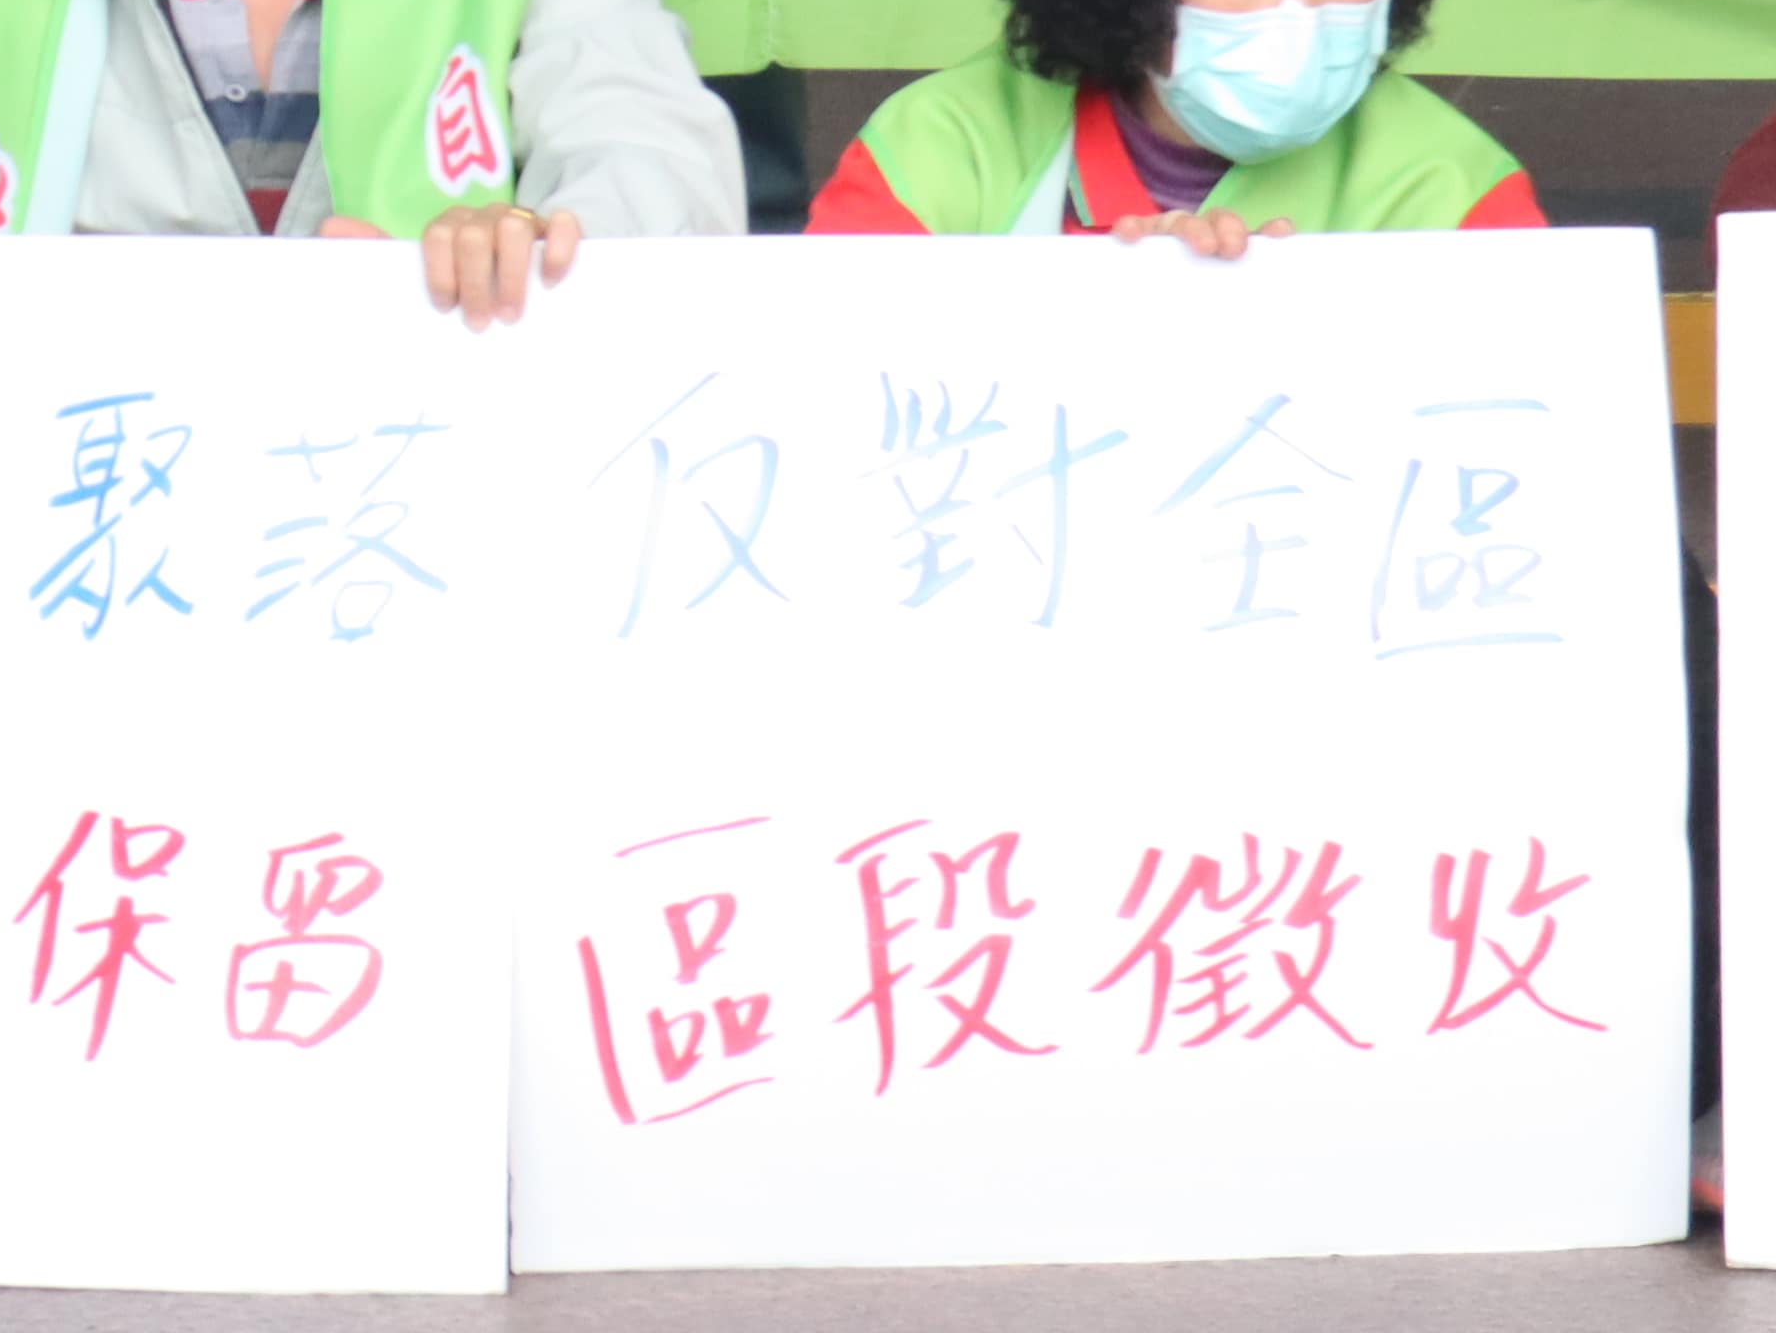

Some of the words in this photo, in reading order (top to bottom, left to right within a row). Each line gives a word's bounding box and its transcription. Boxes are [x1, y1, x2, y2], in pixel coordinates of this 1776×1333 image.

[586, 369, 1566, 661] 反對全區
[576, 813, 1610, 1127] 區段徵收
